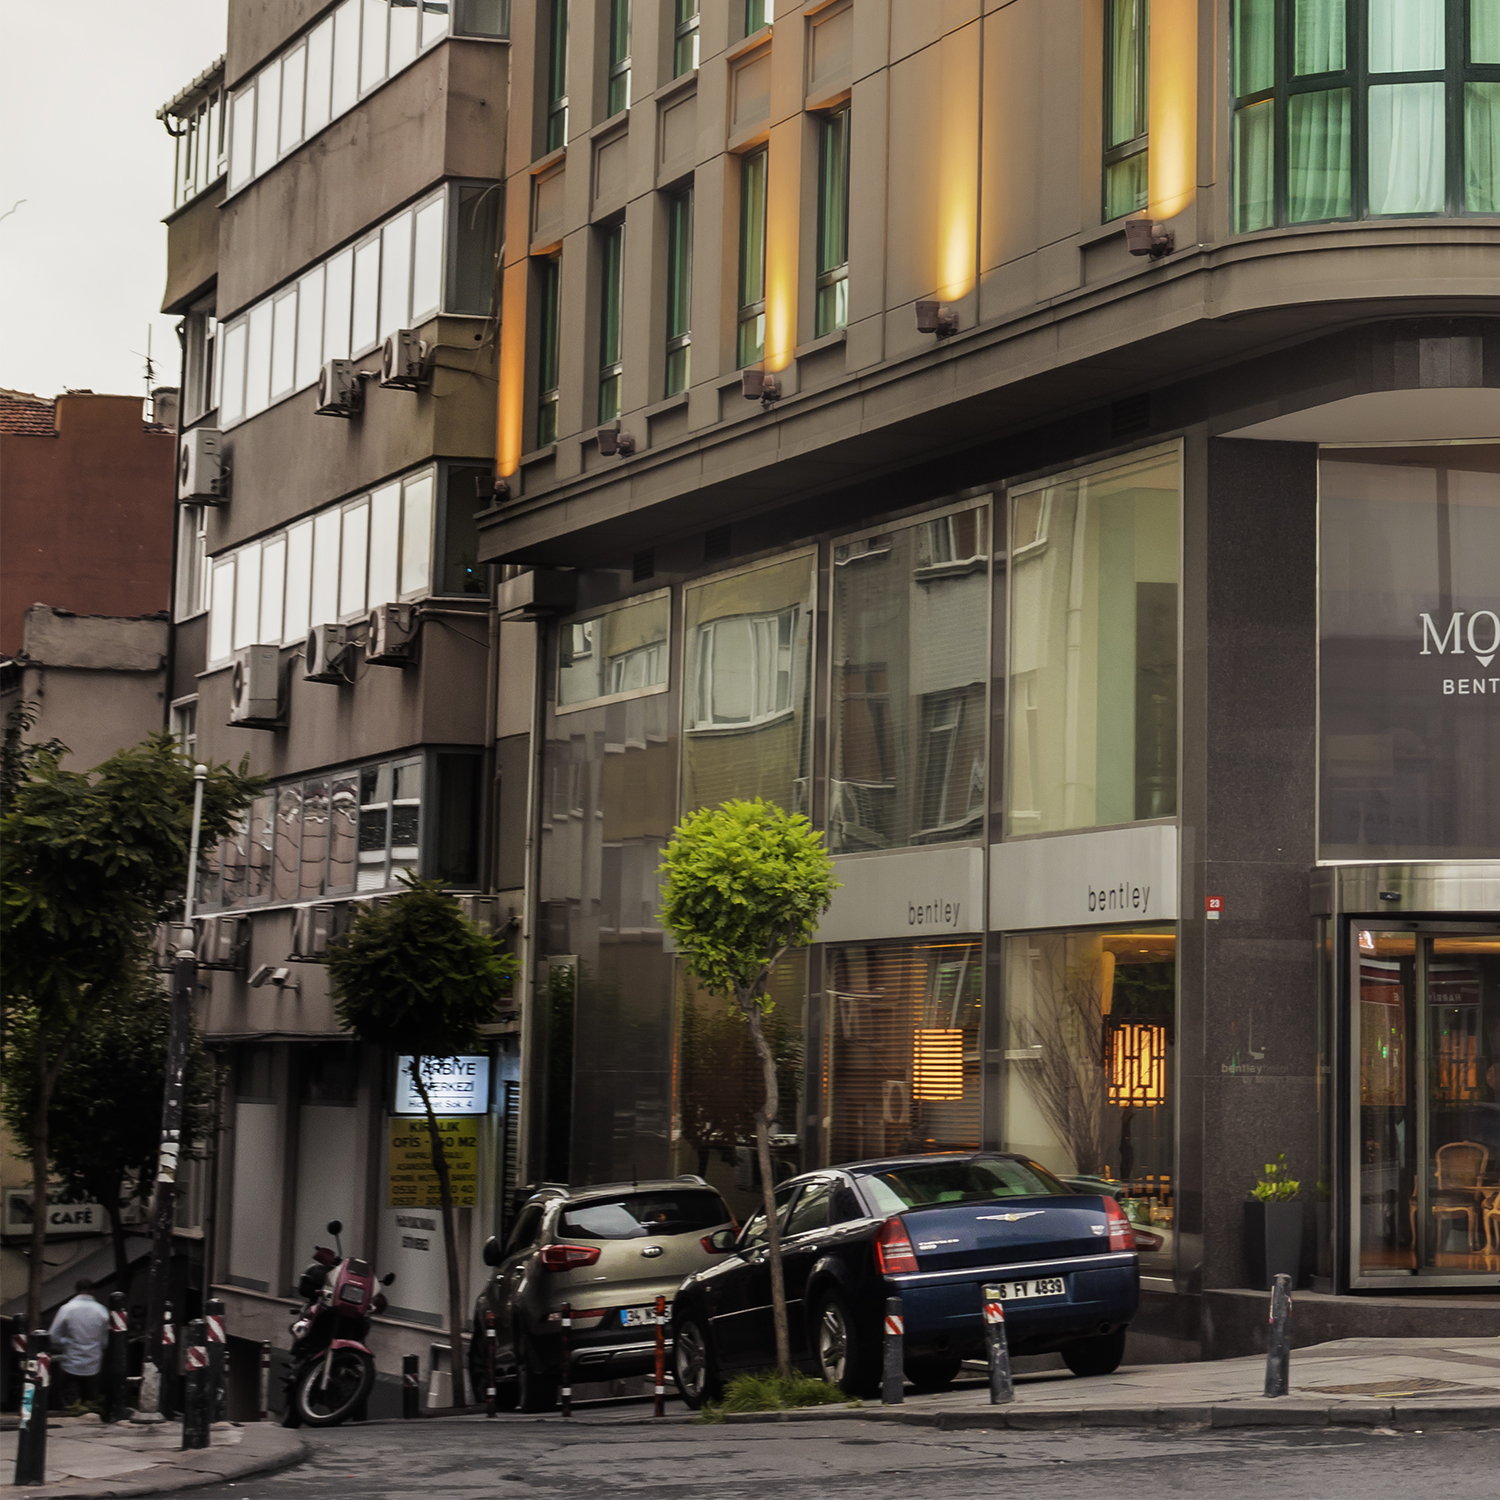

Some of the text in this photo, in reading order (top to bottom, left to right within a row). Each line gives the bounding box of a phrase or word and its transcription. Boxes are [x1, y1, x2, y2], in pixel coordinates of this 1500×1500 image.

[1087, 881, 1151, 914] bentley
[1209, 899, 1220, 908] 23
[908, 898, 961, 928] bentley
[418, 1062, 476, 1076] ARBİYE
[409, 1120, 460, 1132] KİRLIK
[458, 1137, 476, 1148] M2
[1035, 1278, 1063, 1295] 4839
